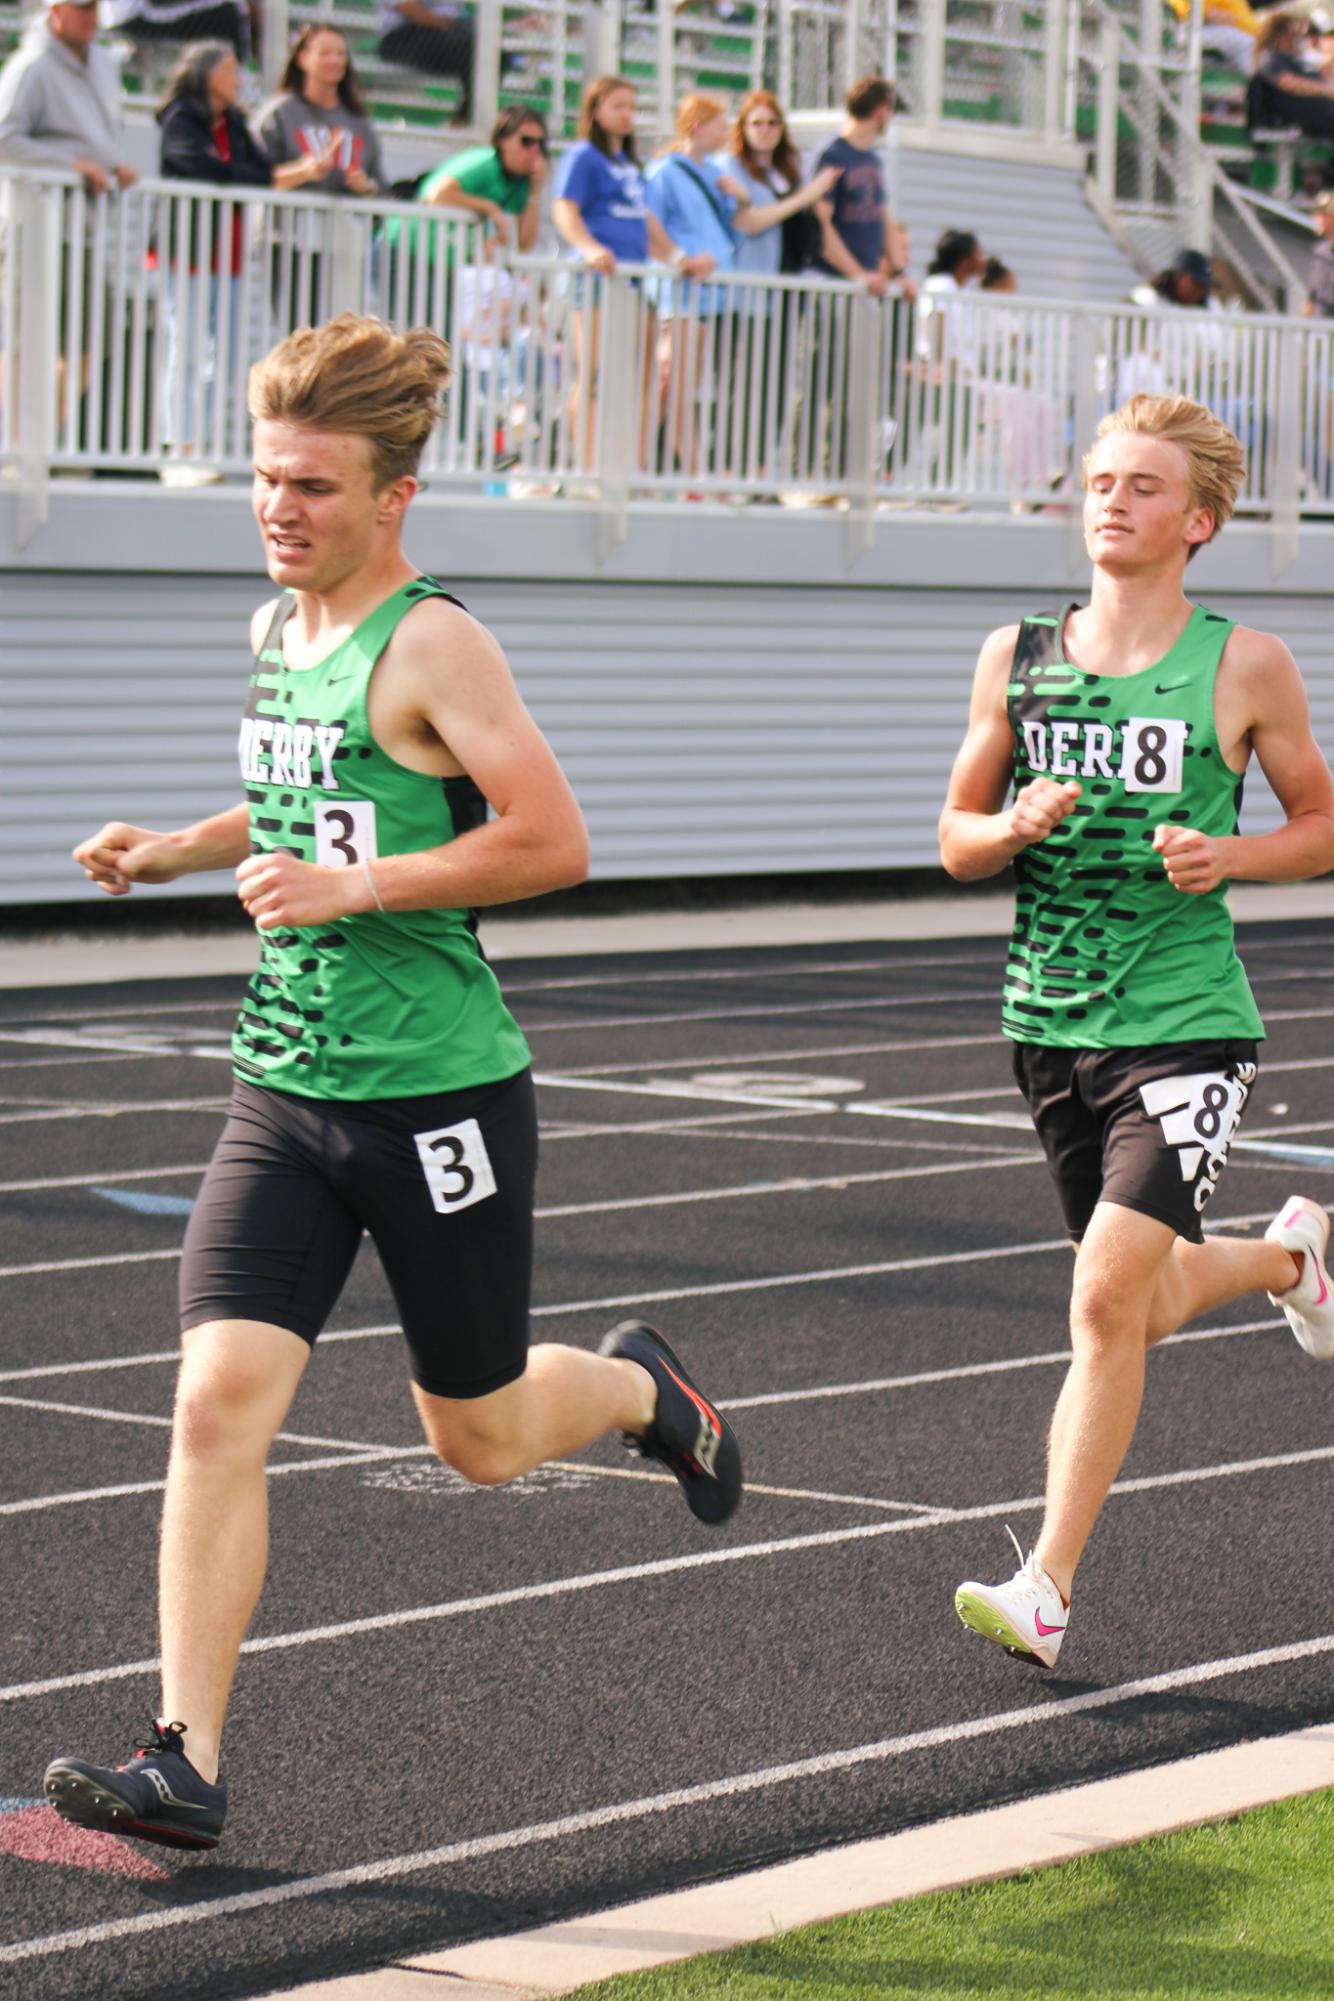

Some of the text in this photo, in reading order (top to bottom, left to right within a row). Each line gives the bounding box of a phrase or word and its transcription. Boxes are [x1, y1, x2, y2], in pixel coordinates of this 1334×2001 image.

[1022, 721, 1188, 780] DER
[1135, 726, 1167, 786] 8
[324, 809, 358, 865] 3
[1194, 1083, 1229, 1139] 8
[429, 1136, 474, 1203] 3
